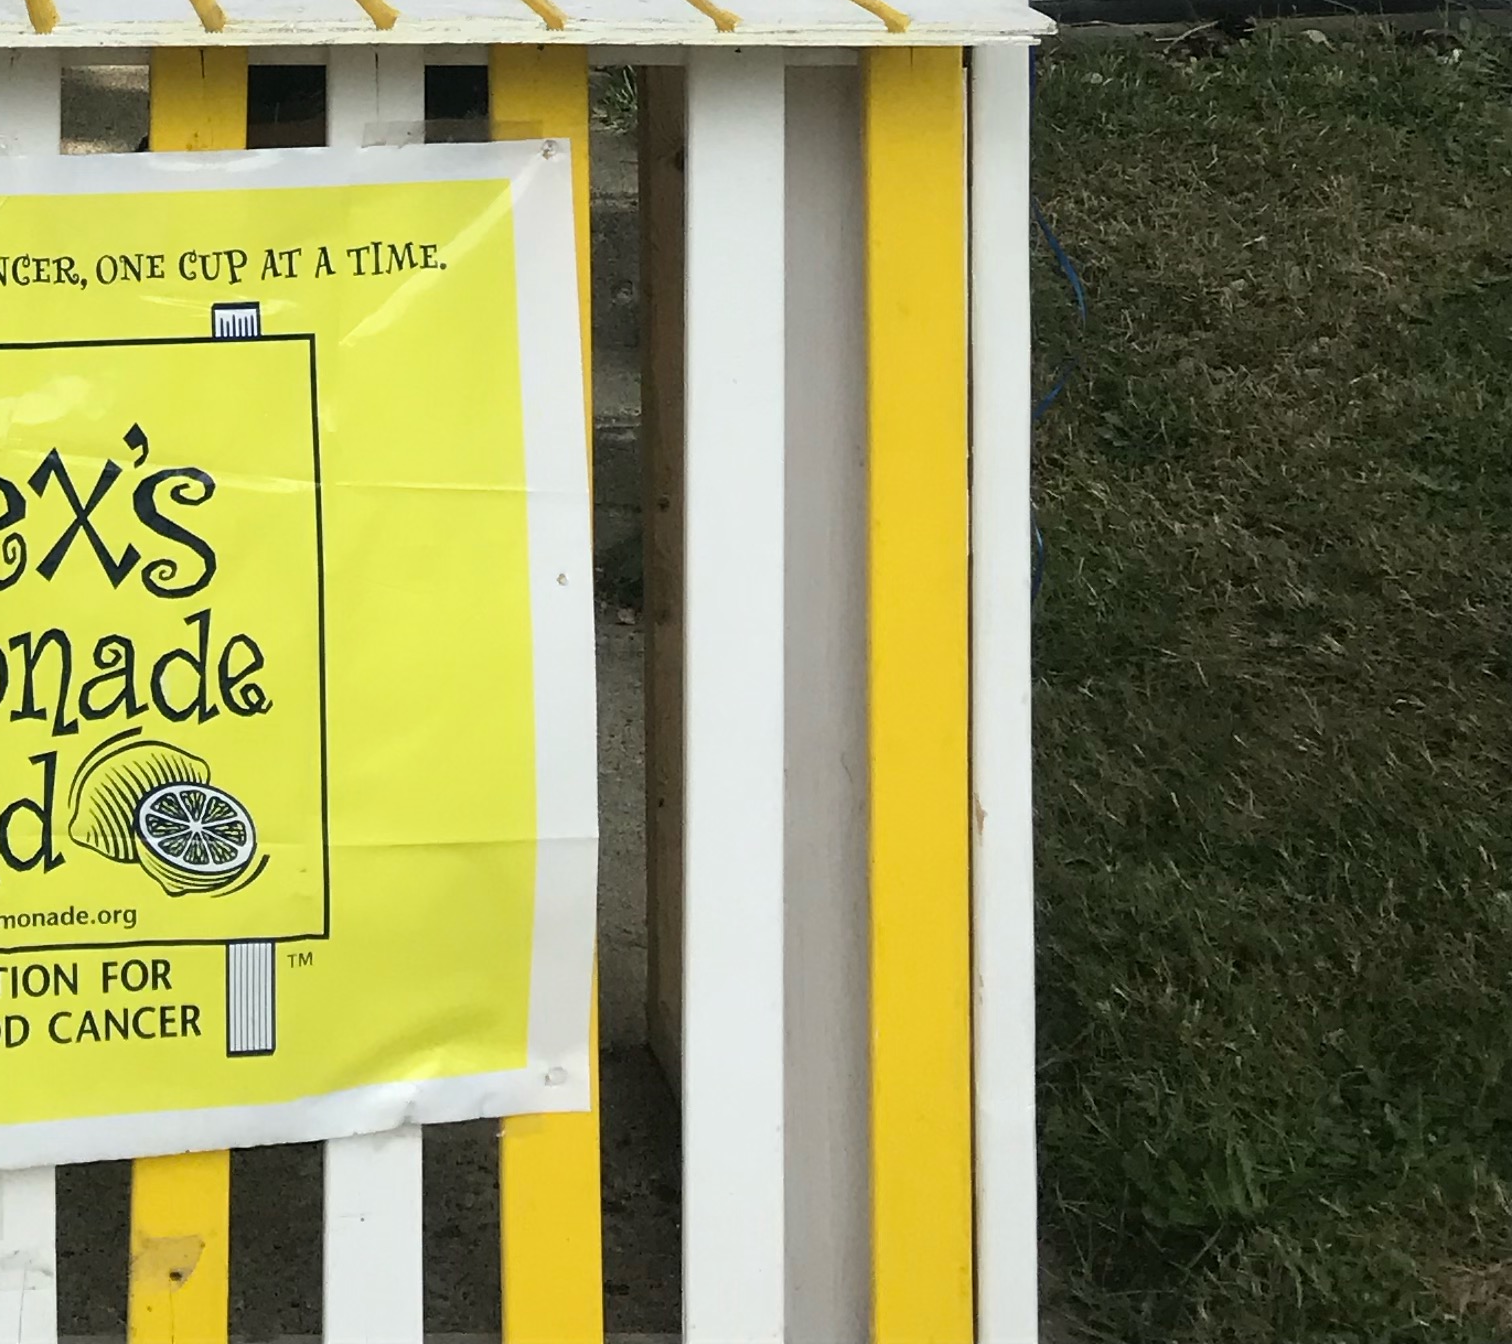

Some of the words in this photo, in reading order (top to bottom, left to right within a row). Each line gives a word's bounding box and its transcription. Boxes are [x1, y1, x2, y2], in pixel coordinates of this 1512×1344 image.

[96, 253, 166, 285] ONE
[178, 251, 248, 287] CUP
[260, 247, 302, 280] AT
[314, 246, 336, 278] A
[347, 240, 448, 273] TIME.
[101, 960, 173, 992] FOR
[47, 1004, 202, 1044] CANCER
